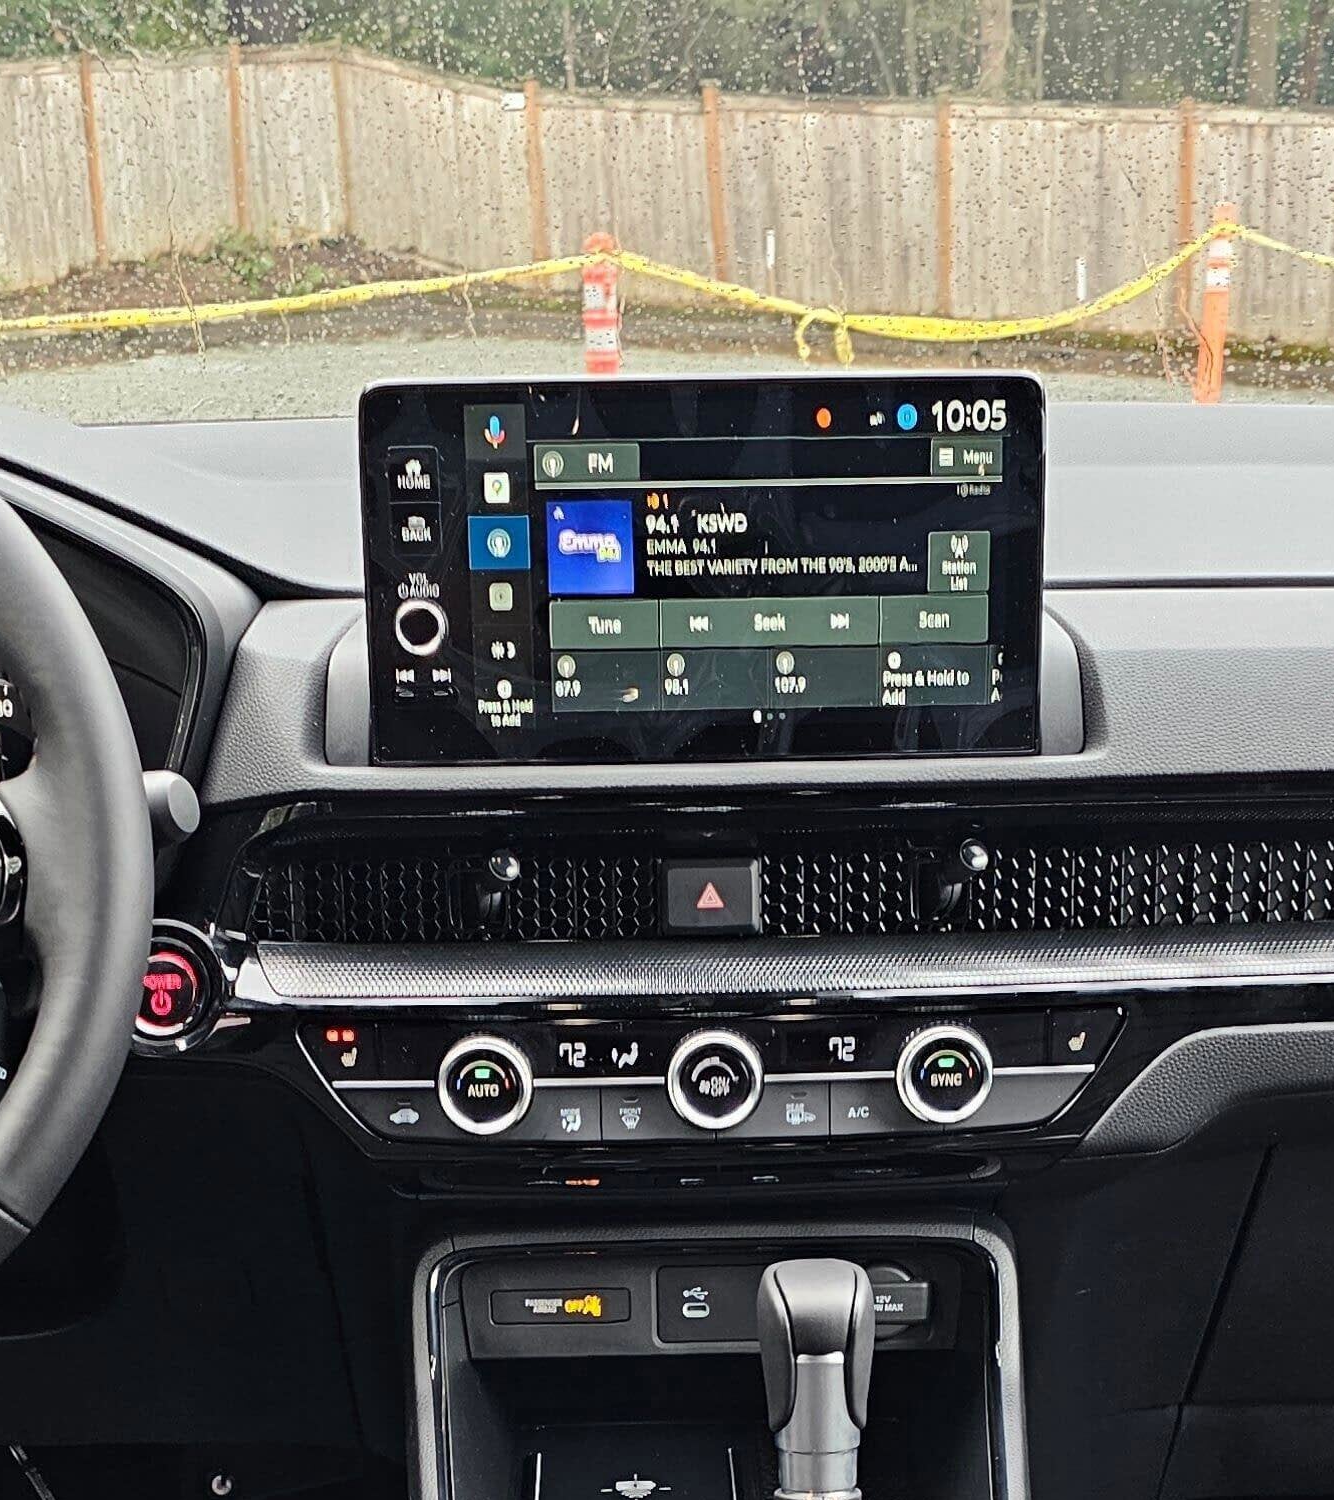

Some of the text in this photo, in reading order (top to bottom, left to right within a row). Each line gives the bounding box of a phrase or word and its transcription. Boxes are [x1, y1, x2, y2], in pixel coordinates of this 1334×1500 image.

[931, 399, 1007, 432] 10:05
[588, 453, 614, 473] FM
[963, 449, 993, 465] Menu
[397, 475, 430, 490] HOME
[645, 513, 748, 534] 94.1 KSWD
[559, 530, 617, 553] Emma
[647, 538, 716, 555] EMMA 94.1
[647, 559, 672, 577] THE
[675, 559, 705, 576] BEST
[709, 558, 758, 575] VARIETY
[761, 557, 798, 575] FROM
[801, 557, 827, 574] THE
[941, 560, 977, 576] Station
[951, 576, 968, 591] List
[588, 616, 622, 635] Tune
[754, 613, 786, 632] Seek
[919, 611, 950, 629] Scan
[775, 676, 807, 694] 107.9
[883, 669, 970, 688] Press & Hold to
[882, 689, 907, 706] Add
[559, 1042, 586, 1068] 72
[829, 1036, 856, 1062] 72
[930, 1073, 963, 1088] SYNC
[467, 1084, 499, 1098] AUTO
[619, 1107, 642, 1116] FRONT
[848, 1106, 869, 1119] A/C
[875, 1295, 892, 1304] 12V
[884, 1303, 904, 1312] MAX
